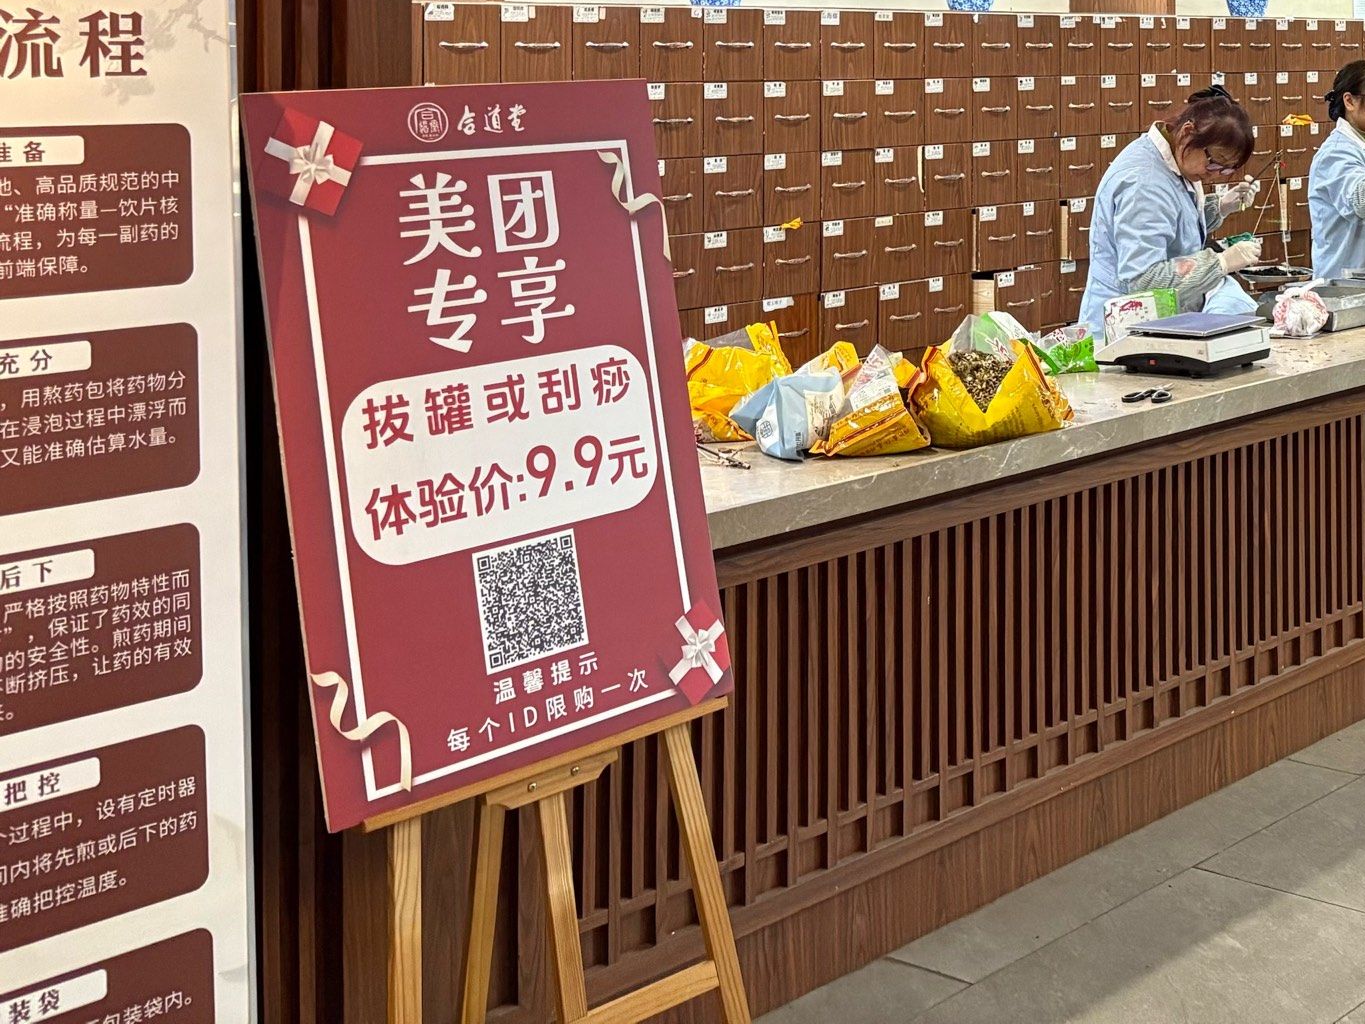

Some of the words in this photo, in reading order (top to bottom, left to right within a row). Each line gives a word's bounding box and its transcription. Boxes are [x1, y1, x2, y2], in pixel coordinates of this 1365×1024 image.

[0, 7, 148, 79] 流程
[457, 103, 527, 136] 合道堂
[399, 170, 562, 266] 美团
[407, 256, 575, 354] 专享
[0, 348, 53, 375] 充分
[0, 396, 188, 440] 在浸泡过程中漂浮而
[361, 356, 631, 451] 拔罐或刮痧
[0, 426, 177, 469] 又能准确估算水量。
[0, 559, 54, 590] 后下
[3, 568, 190, 624] 严格按照药物特性而
[0, 614, 192, 672] 的安全性。煎药期间
[0, 636, 192, 695] 断挤压，让药的有效
[492, 651, 599, 705] 温馨提示
[446, 666, 650, 753] 每个ID限购一次
[4, 772, 61, 807] 把控
[8, 988, 61, 1024] 装袋
[86, 990, 192, 1024] 包装袋内。
